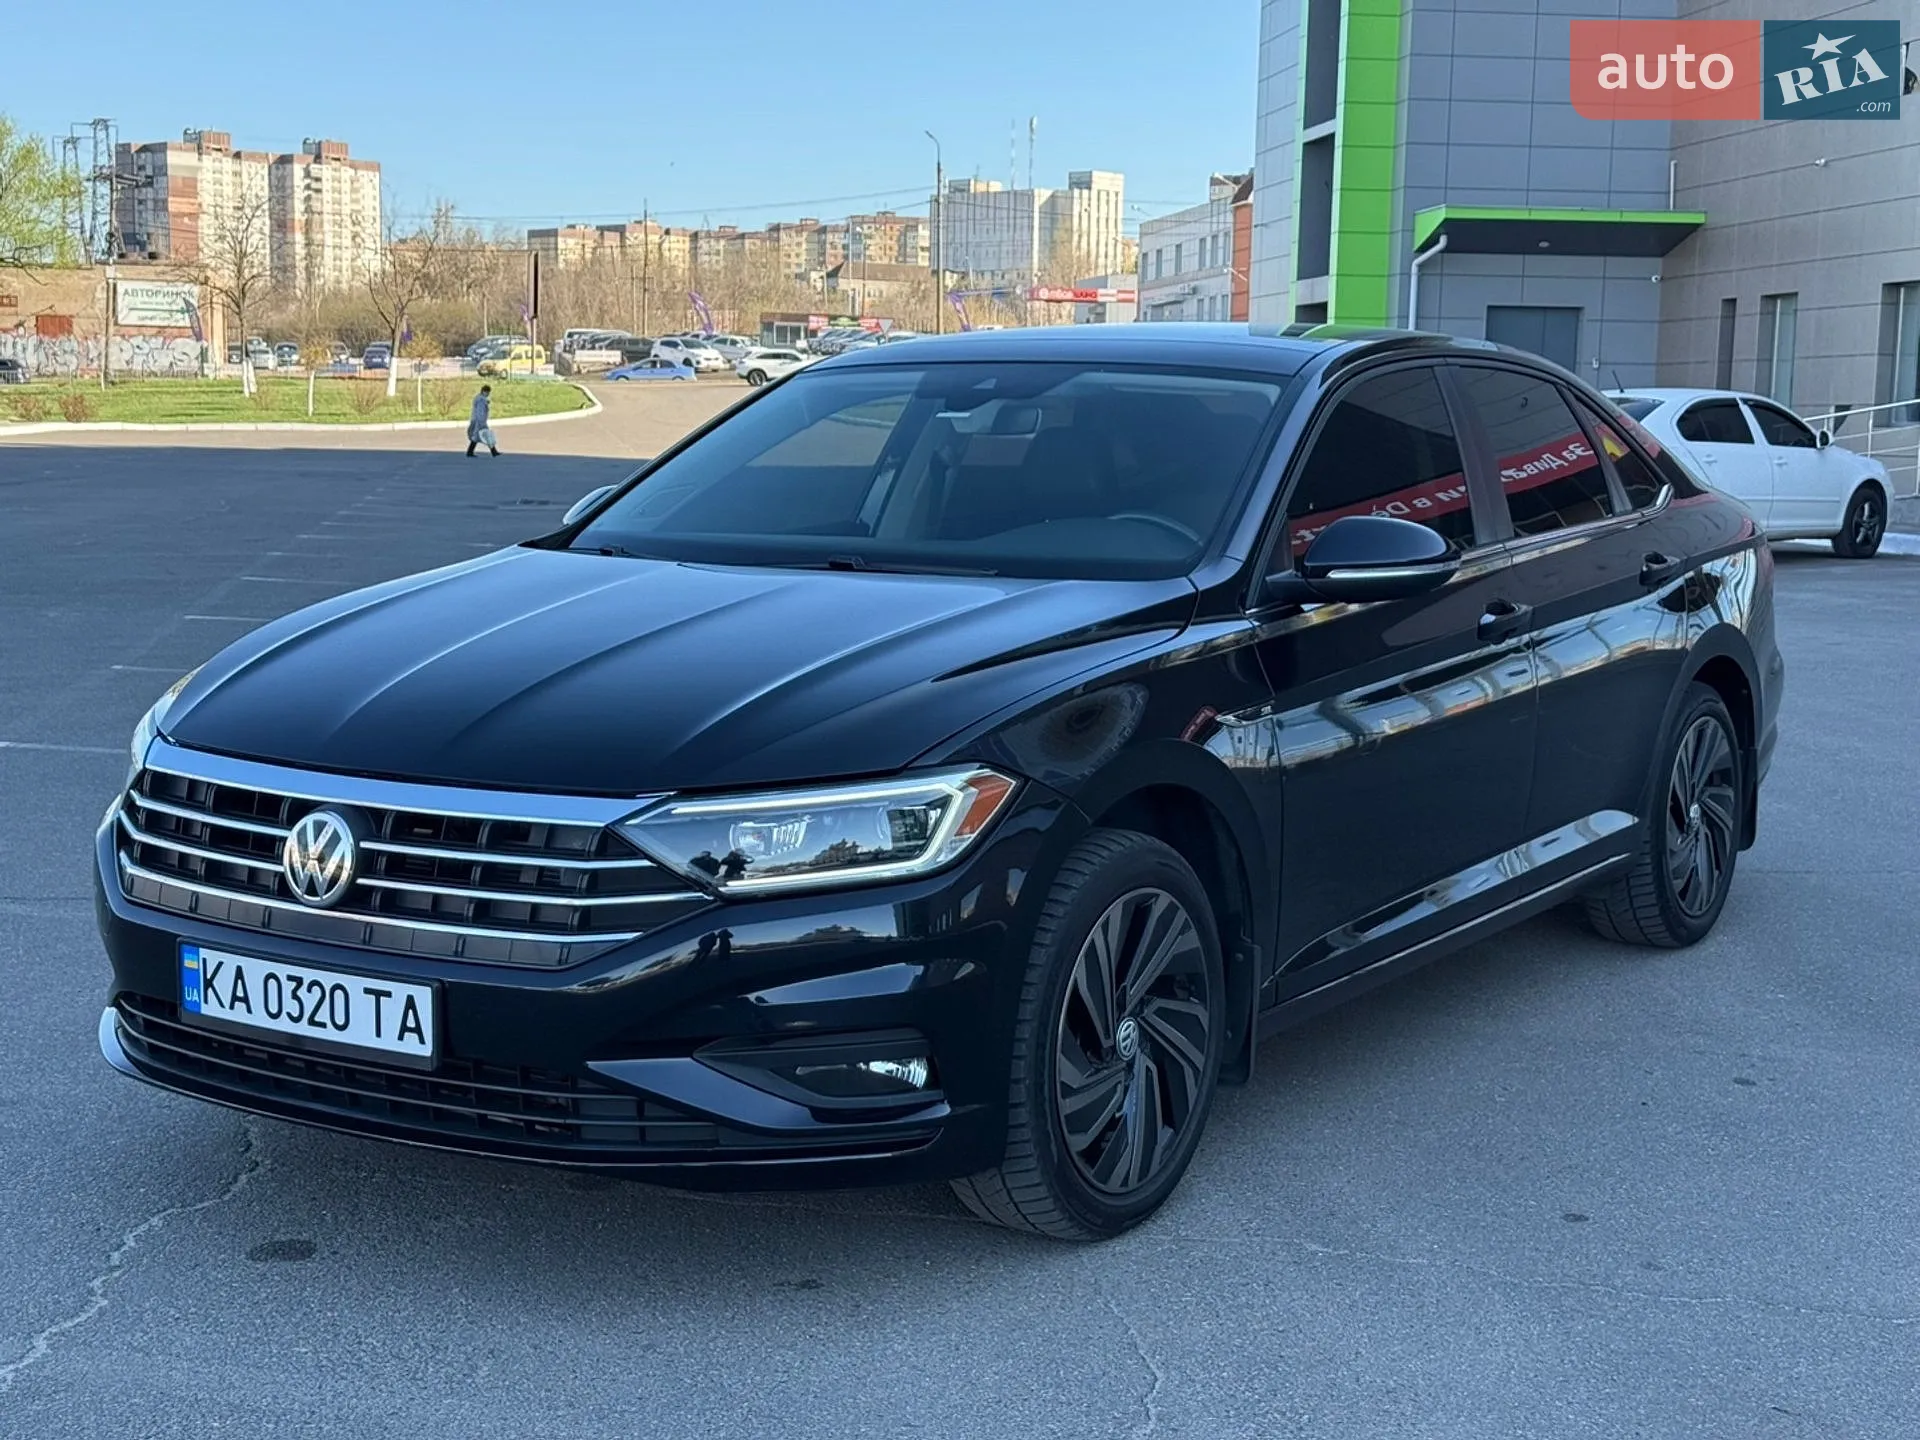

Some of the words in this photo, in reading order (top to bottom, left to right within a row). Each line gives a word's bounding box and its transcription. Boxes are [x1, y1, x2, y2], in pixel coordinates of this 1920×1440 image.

[283, 811, 355, 907] VW
[184, 986, 200, 1003] UA
[201, 957, 253, 1015] KA
[263, 971, 350, 1032] 0320
[362, 986, 426, 1045] TA
